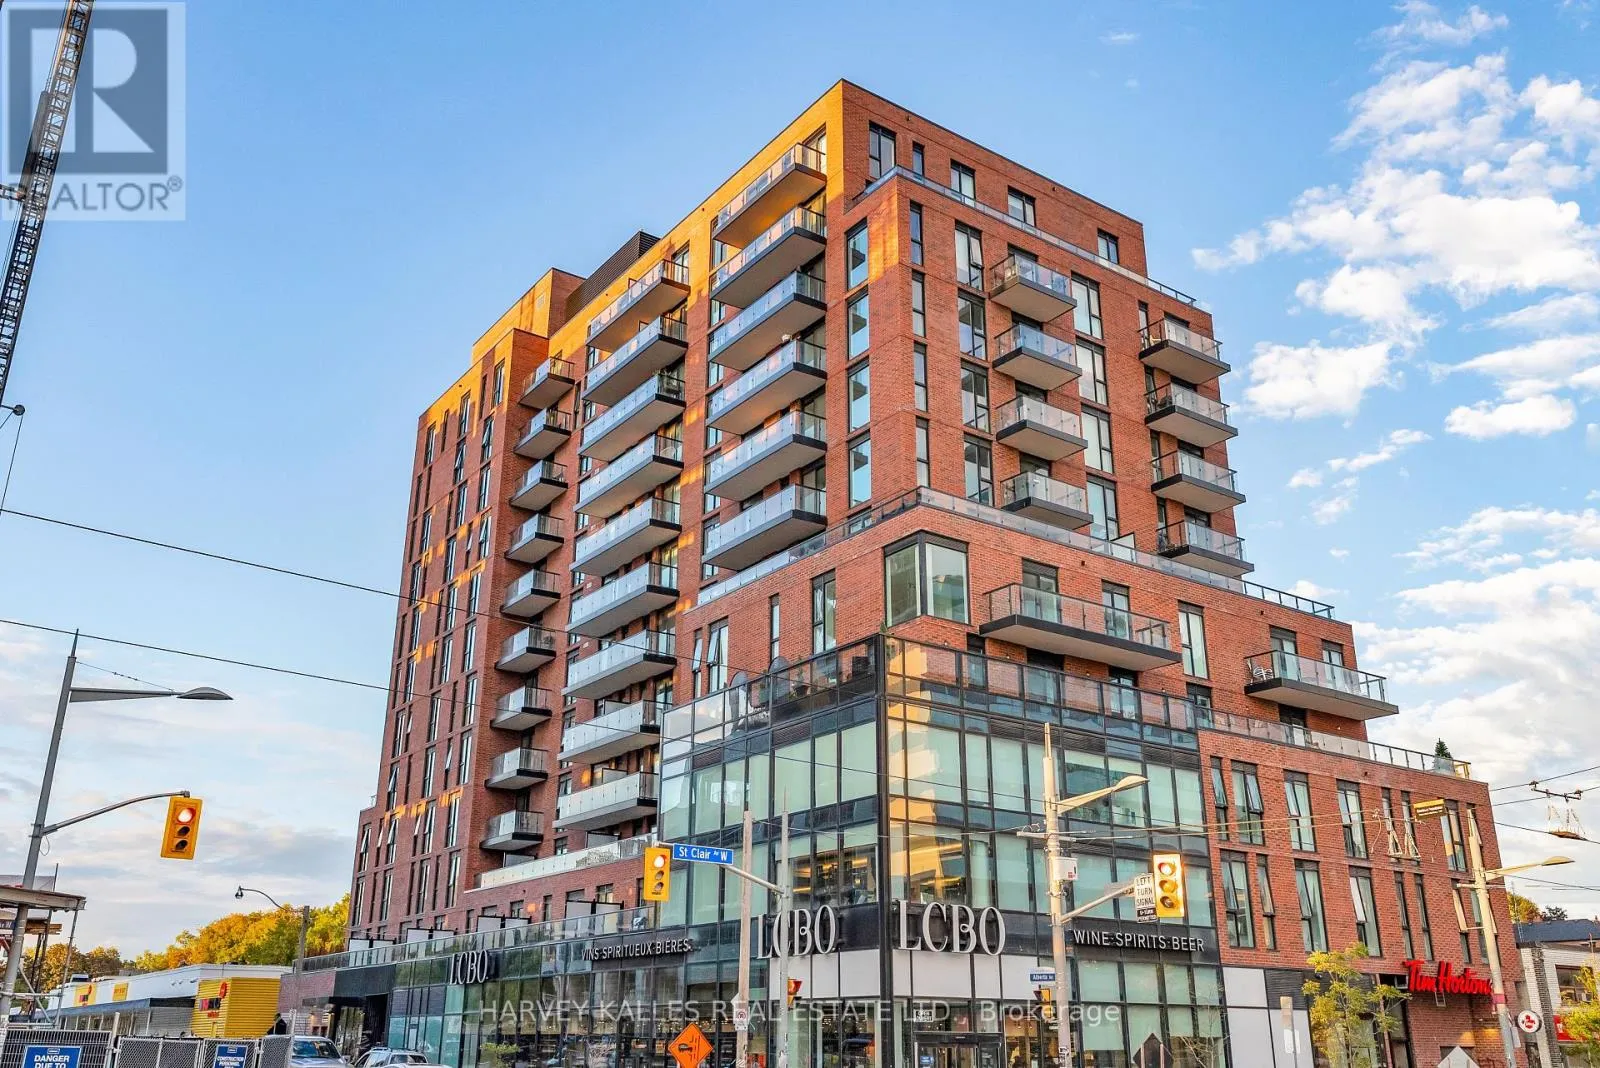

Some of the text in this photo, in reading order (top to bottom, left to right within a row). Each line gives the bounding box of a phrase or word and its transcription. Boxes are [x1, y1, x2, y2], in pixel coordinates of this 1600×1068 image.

[679, 846, 688, 857] St
[691, 847, 711, 860] Clair
[721, 851, 728, 861] W
[1136, 877, 1151, 886] LEFT
[1137, 888, 1153, 896] TURN
[1137, 897, 1155, 906] SIGNAL
[757, 904, 837, 959] LCBO
[899, 899, 1006, 956] LCBO
[1073, 929, 1205, 952] WINE SPIRITS BEER
[581, 947, 600, 961] VINS
[602, 942, 652, 960] SPIRITUEUX
[450, 949, 488, 985] LCBO
[1403, 960, 1437, 993] Tim
[34, 1055, 70, 1063] DANGER
